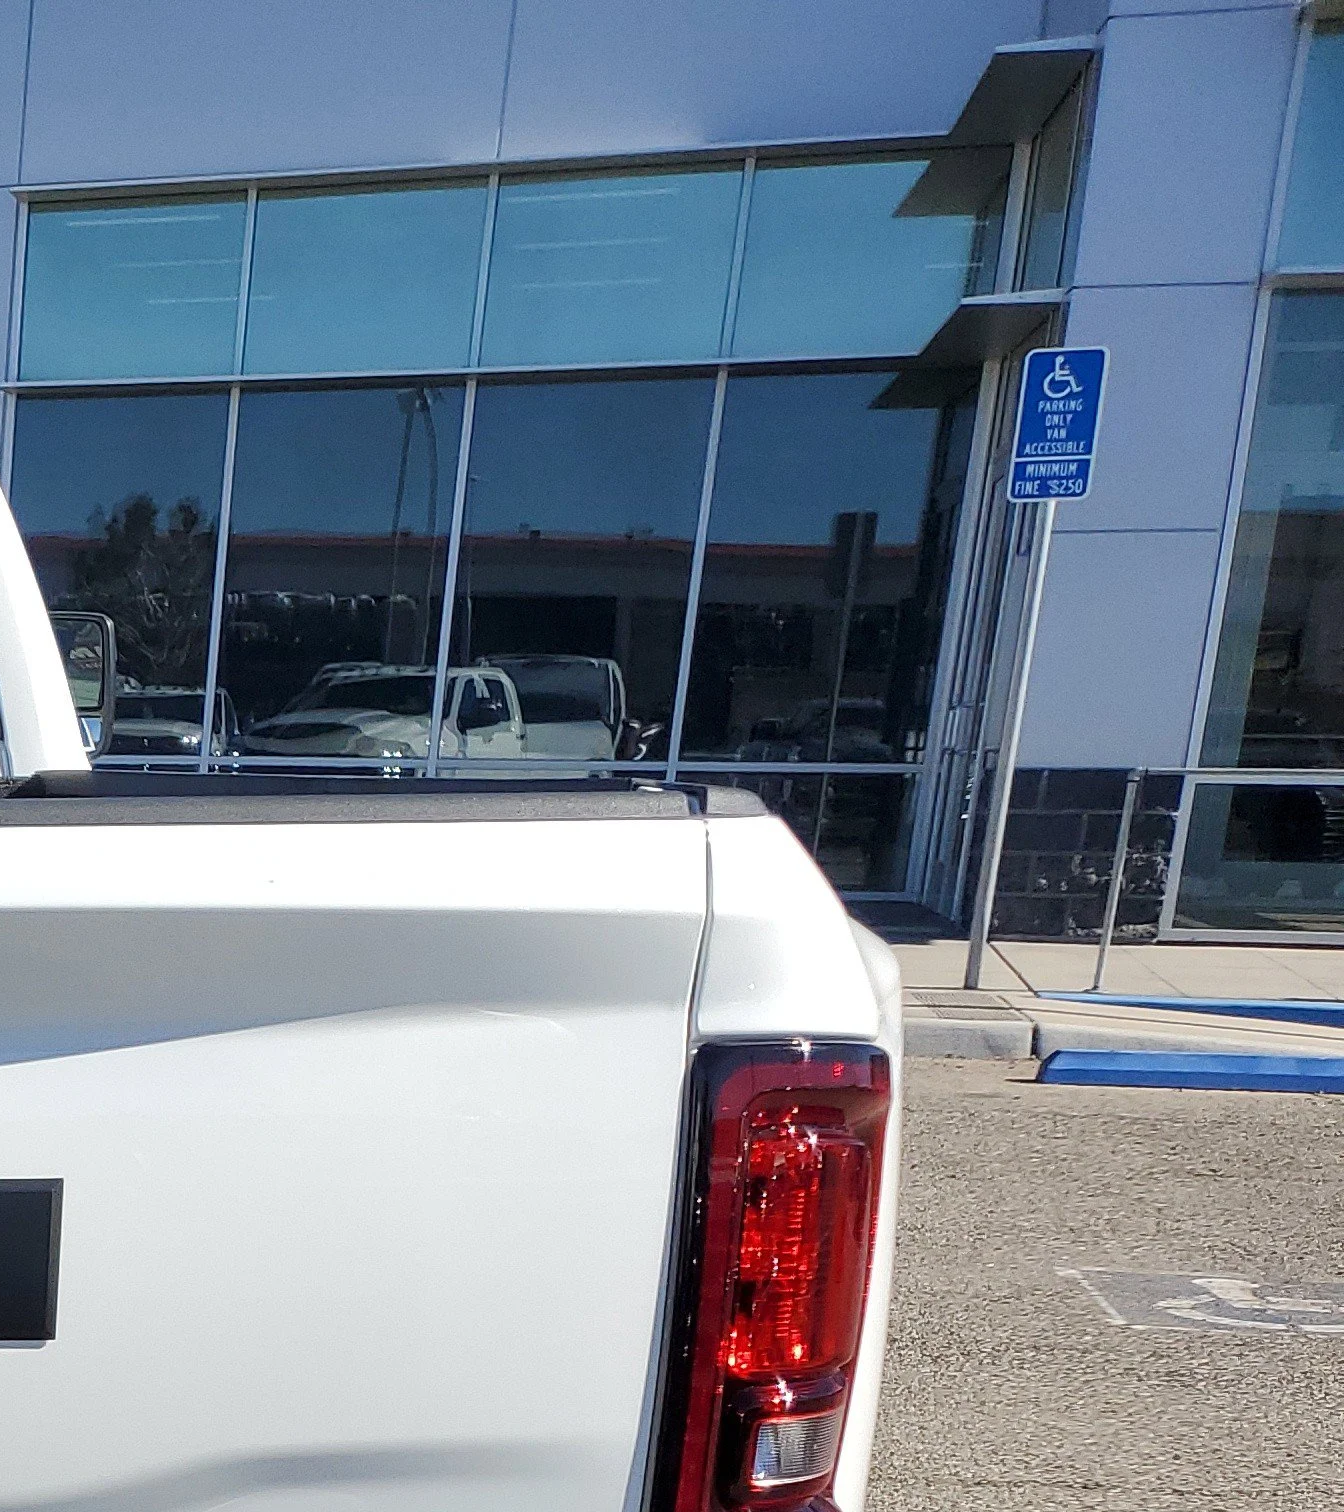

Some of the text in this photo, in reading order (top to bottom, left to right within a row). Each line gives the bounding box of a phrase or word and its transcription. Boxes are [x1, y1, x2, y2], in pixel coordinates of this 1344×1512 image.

[1038, 399, 1084, 413] PARKING
[1045, 414, 1073, 427] ONLY
[1047, 428, 1067, 440] VAN
[1023, 442, 1086, 455] ACCESSIBLE
[1025, 462, 1078, 478] MINIMUM
[1015, 479, 1083, 496] FINE $250
